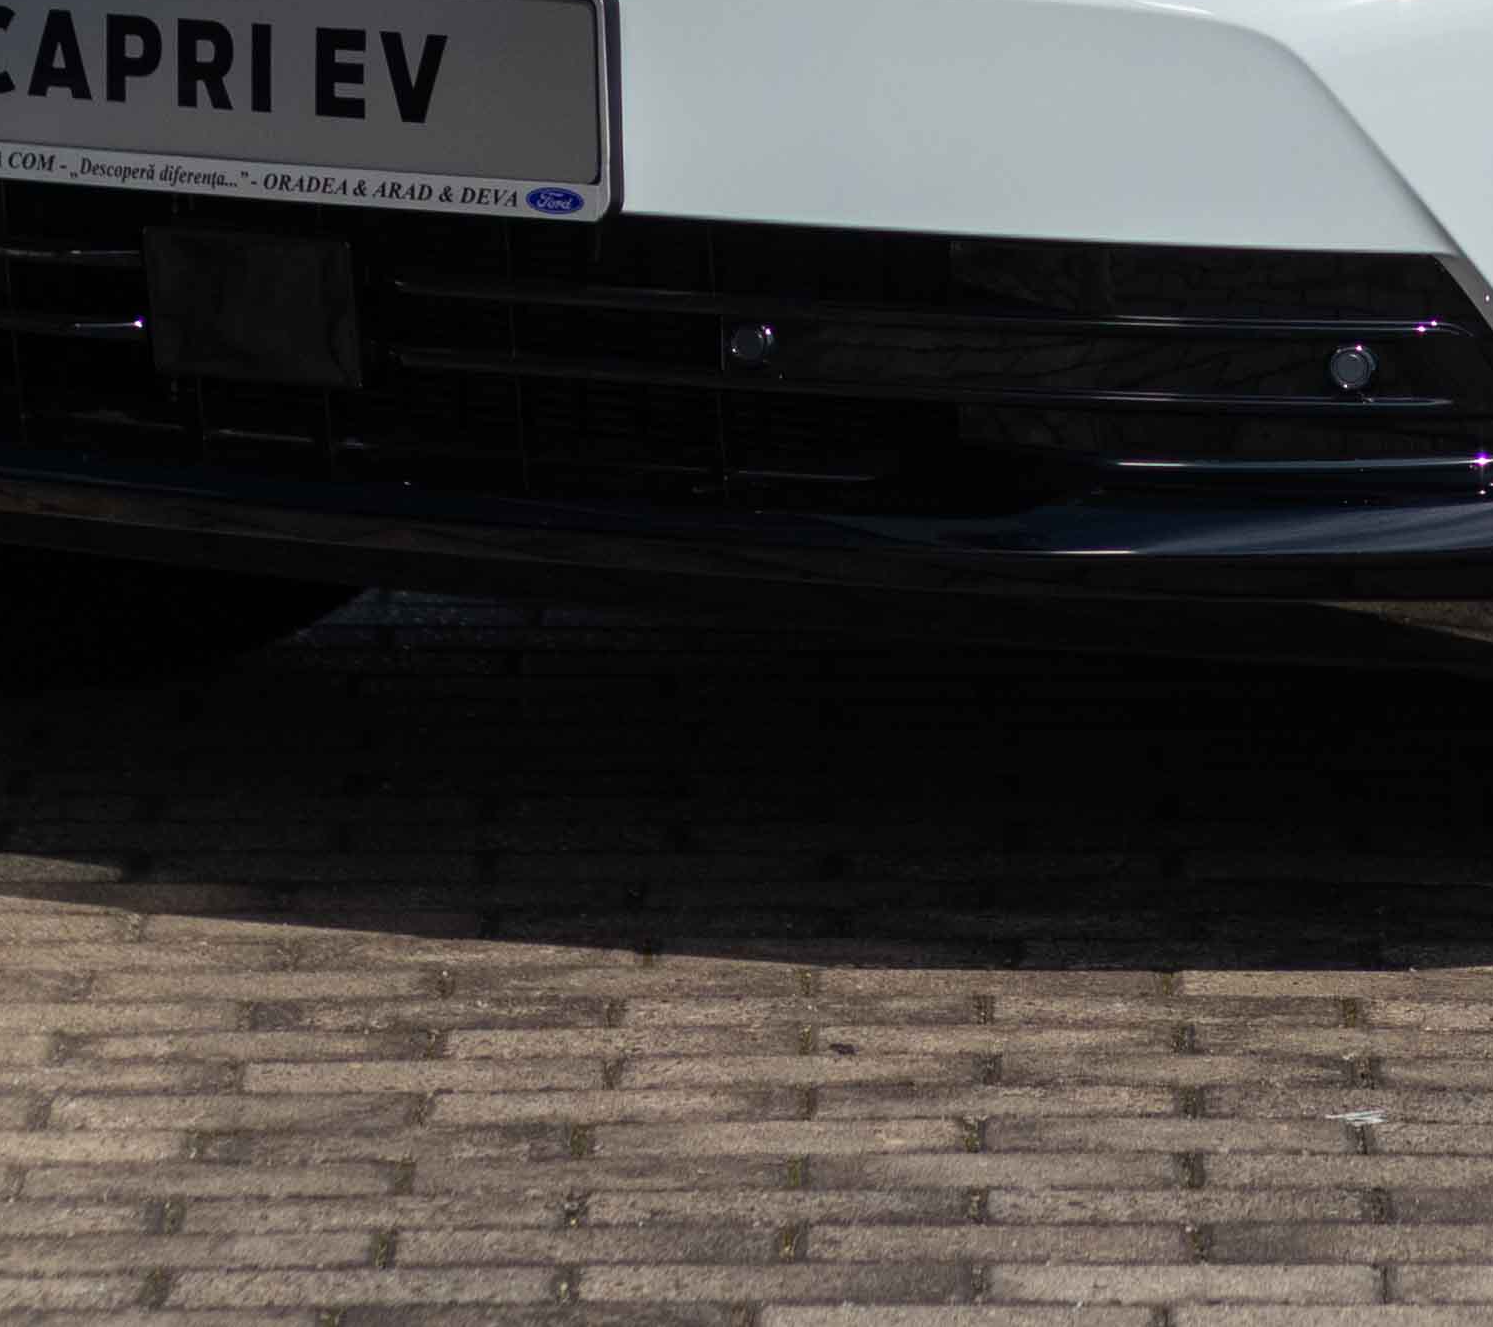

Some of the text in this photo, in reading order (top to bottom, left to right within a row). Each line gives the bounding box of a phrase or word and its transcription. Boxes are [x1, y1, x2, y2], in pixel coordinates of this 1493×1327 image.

[315, 26, 448, 123] EV
[8, 155, 55, 172] COM
[263, 172, 348, 196] ORADEA
[353, 180, 368, 196] &
[372, 183, 433, 201] ARAD
[438, 187, 454, 203] &
[460, 187, 519, 208] DEVA
